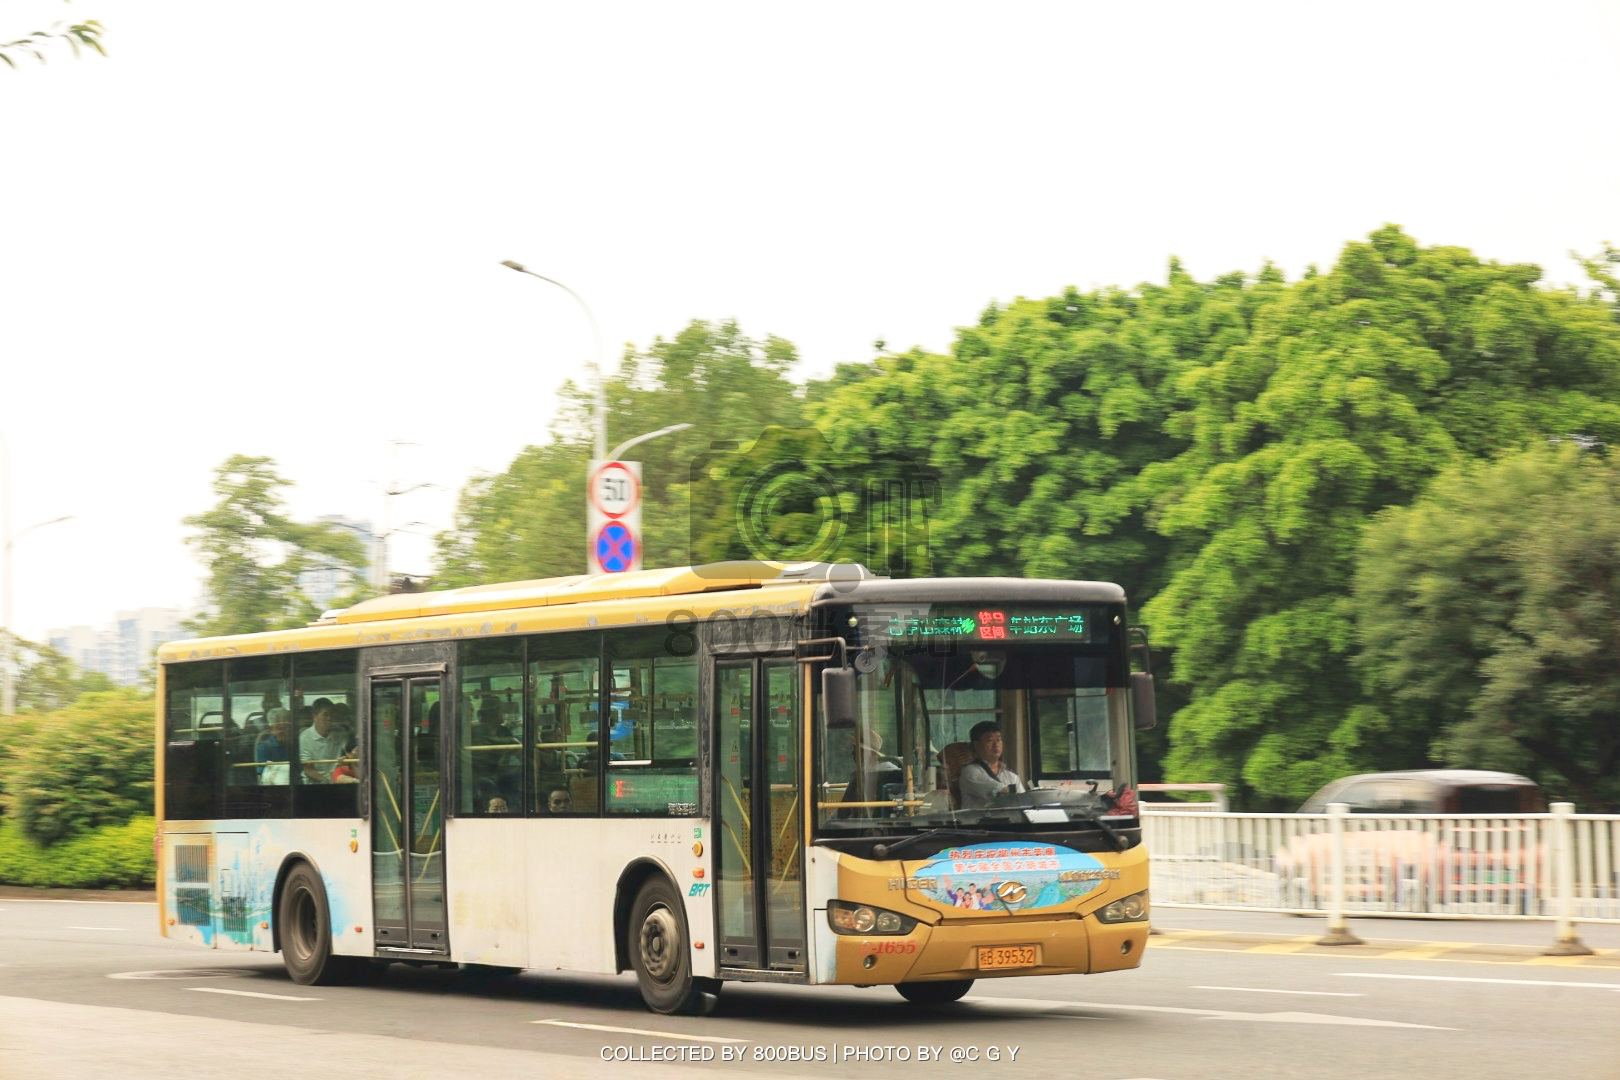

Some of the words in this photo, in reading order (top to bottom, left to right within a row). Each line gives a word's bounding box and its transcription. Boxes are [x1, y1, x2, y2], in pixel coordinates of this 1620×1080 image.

[980, 626, 1005, 639] 区间
[688, 883, 711, 897] BRT
[888, 877, 938, 890] HIGER
[997, 949, 1034, 965] 39532
